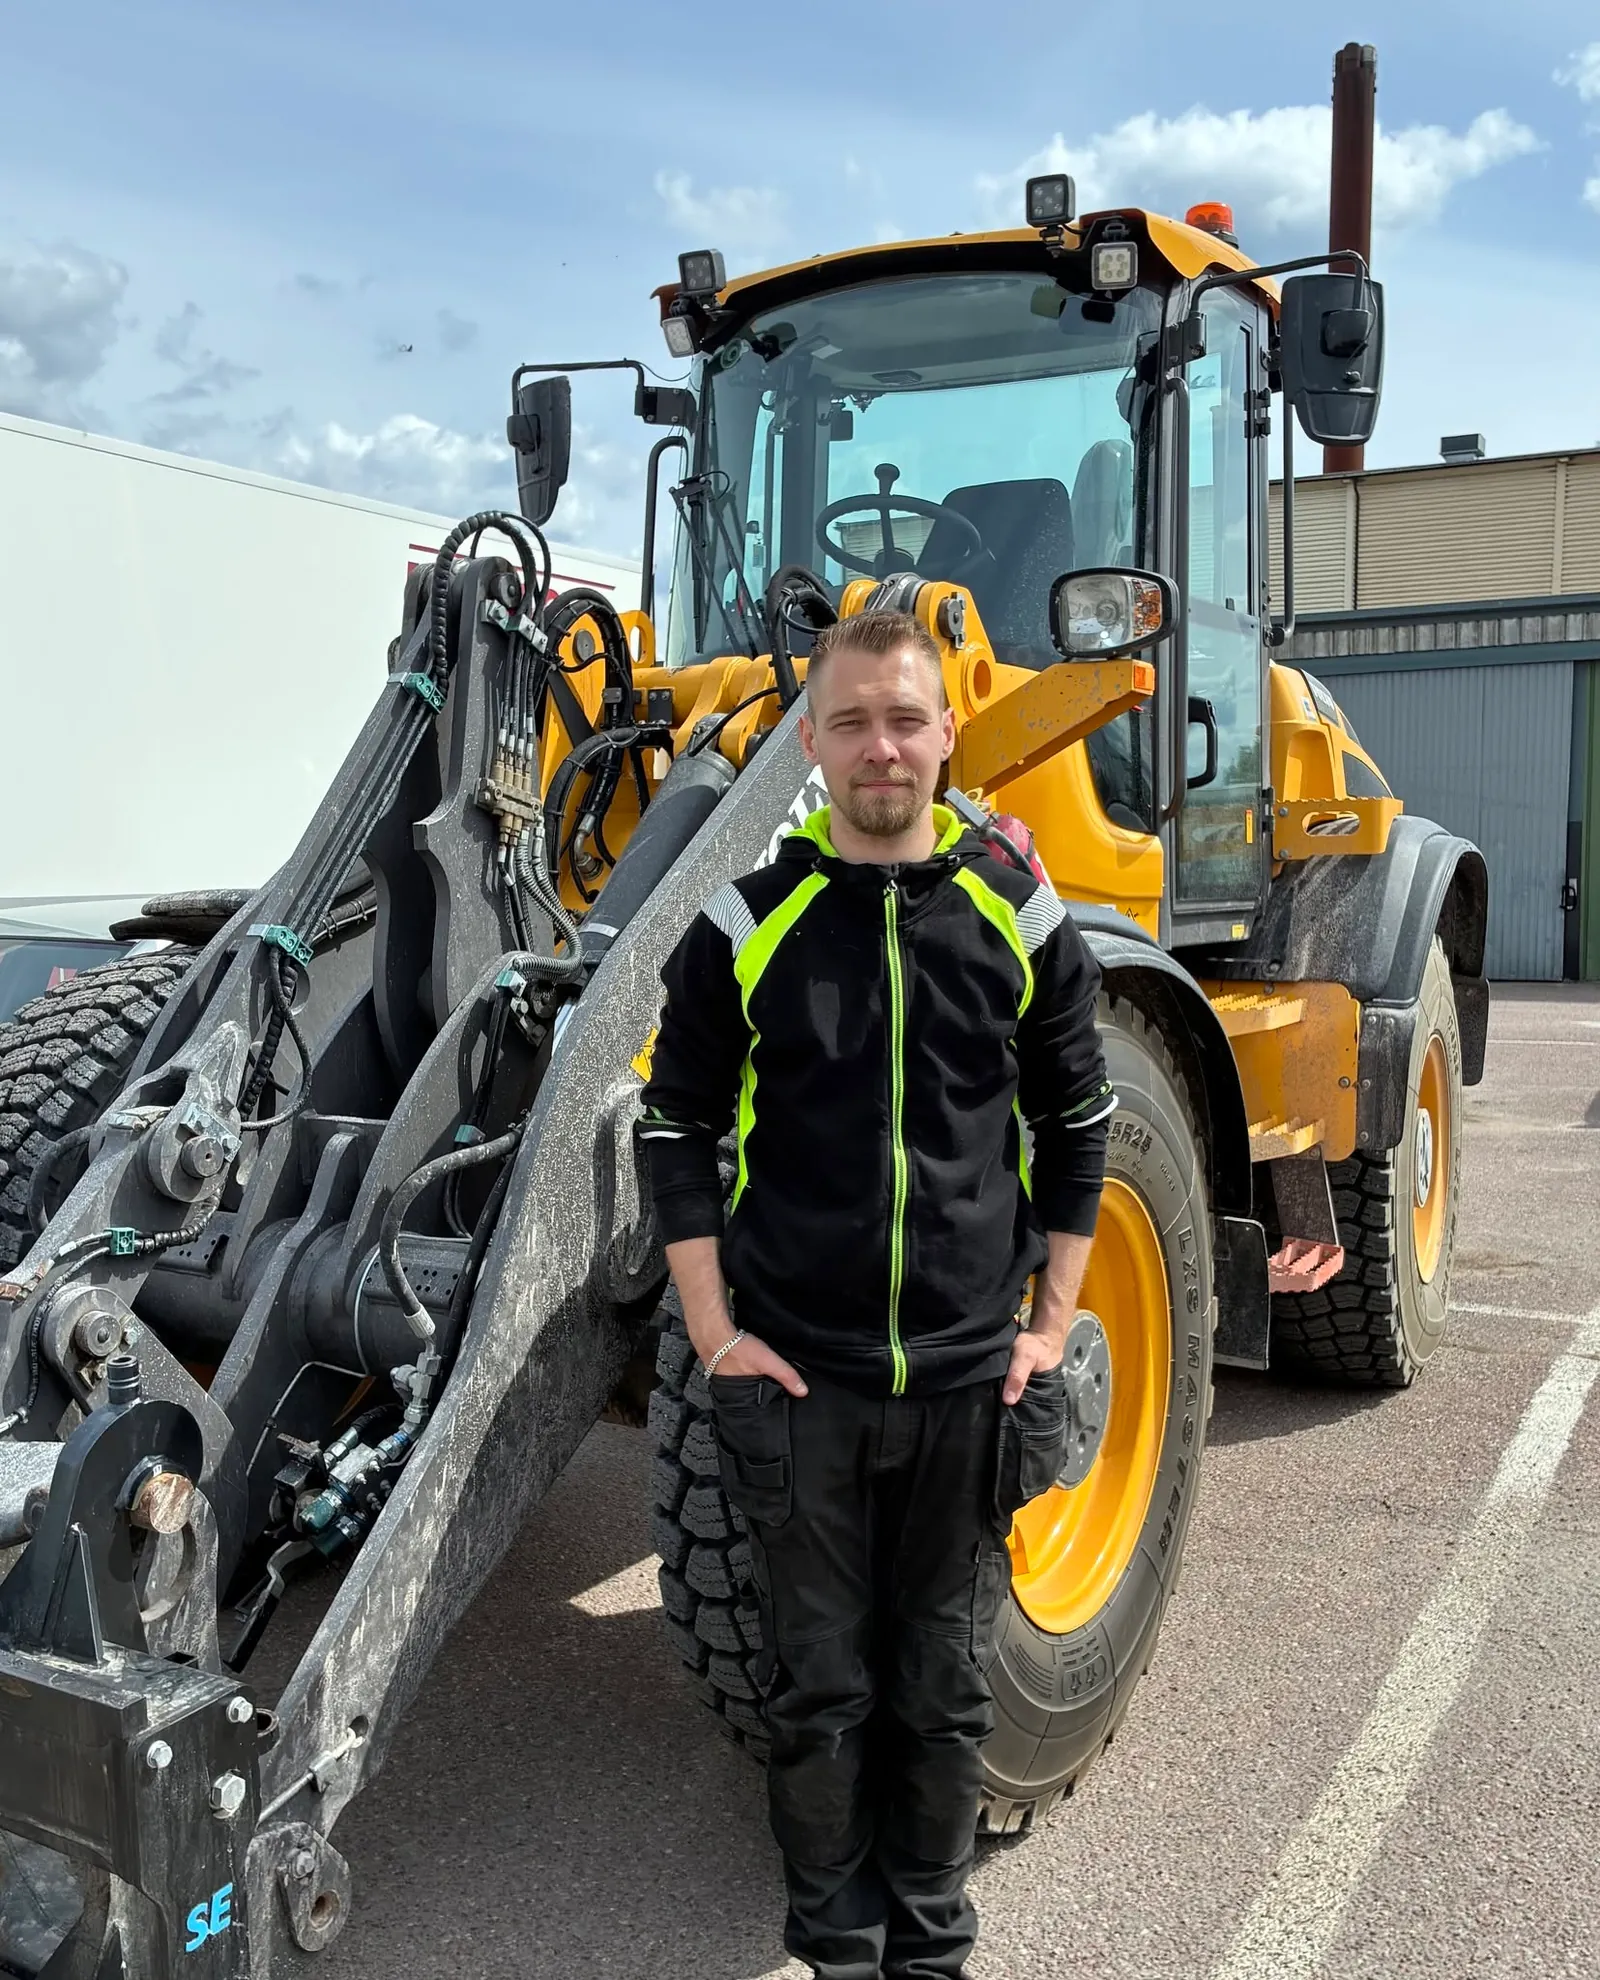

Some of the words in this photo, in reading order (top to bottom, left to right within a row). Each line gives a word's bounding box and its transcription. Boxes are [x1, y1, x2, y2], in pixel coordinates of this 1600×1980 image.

[1177, 1226, 1199, 1314] LXS
[1158, 1331, 1200, 1558] MASTER
[185, 1882, 234, 1953] SE
